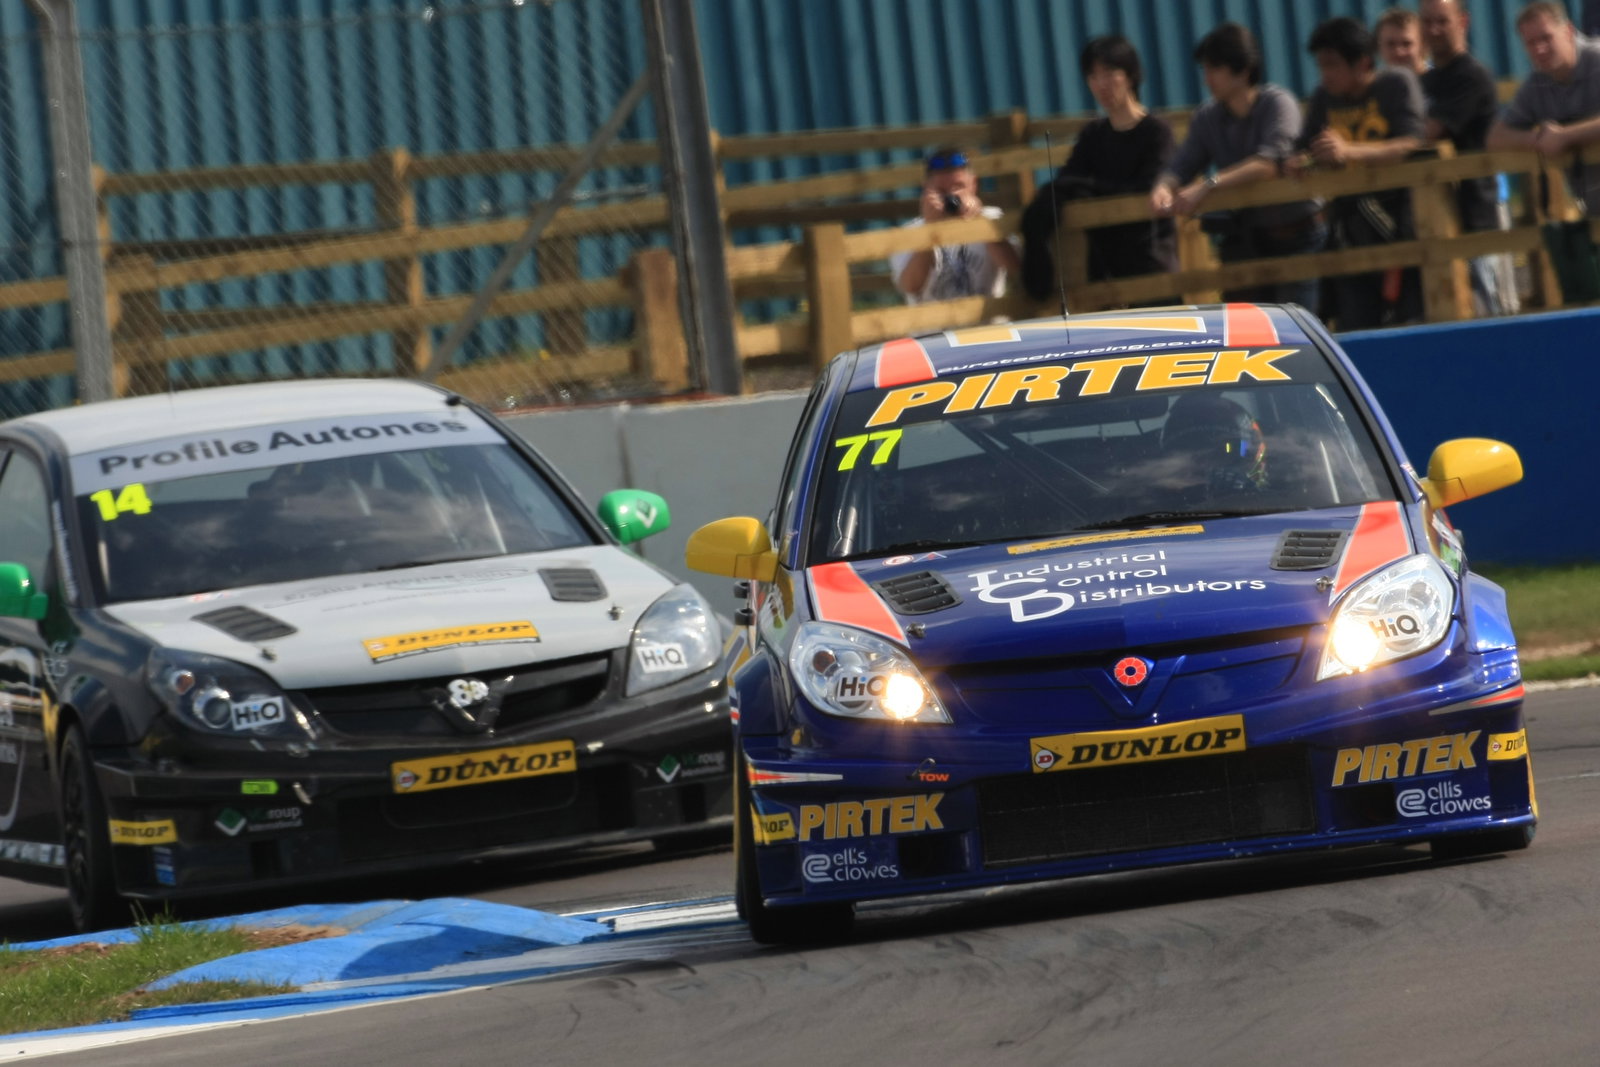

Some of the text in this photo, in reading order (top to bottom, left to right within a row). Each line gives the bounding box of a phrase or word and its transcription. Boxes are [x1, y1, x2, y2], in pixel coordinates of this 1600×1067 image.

[865, 349, 1300, 428] PIRTEK
[98, 421, 469, 475] Profile Autones
[835, 428, 903, 471] 77
[90, 482, 153, 521] 14
[968, 550, 1166, 592] Industrial
[978, 565, 1168, 604] Control
[1009, 579, 1266, 622] Distributors
[1367, 614, 1421, 639] HiQ
[640, 643, 684, 670] HiQ
[234, 700, 281, 727] HiQ
[1067, 728, 1242, 766] DUNLOP
[1331, 729, 1482, 787] PIRTEK
[426, 750, 572, 785] DUNLOP
[920, 772, 950, 782] TOW
[1427, 780, 1463, 801] ellis
[1429, 795, 1492, 816] clowes
[798, 793, 945, 842] PIRTEK
[834, 863, 899, 881] clowes
